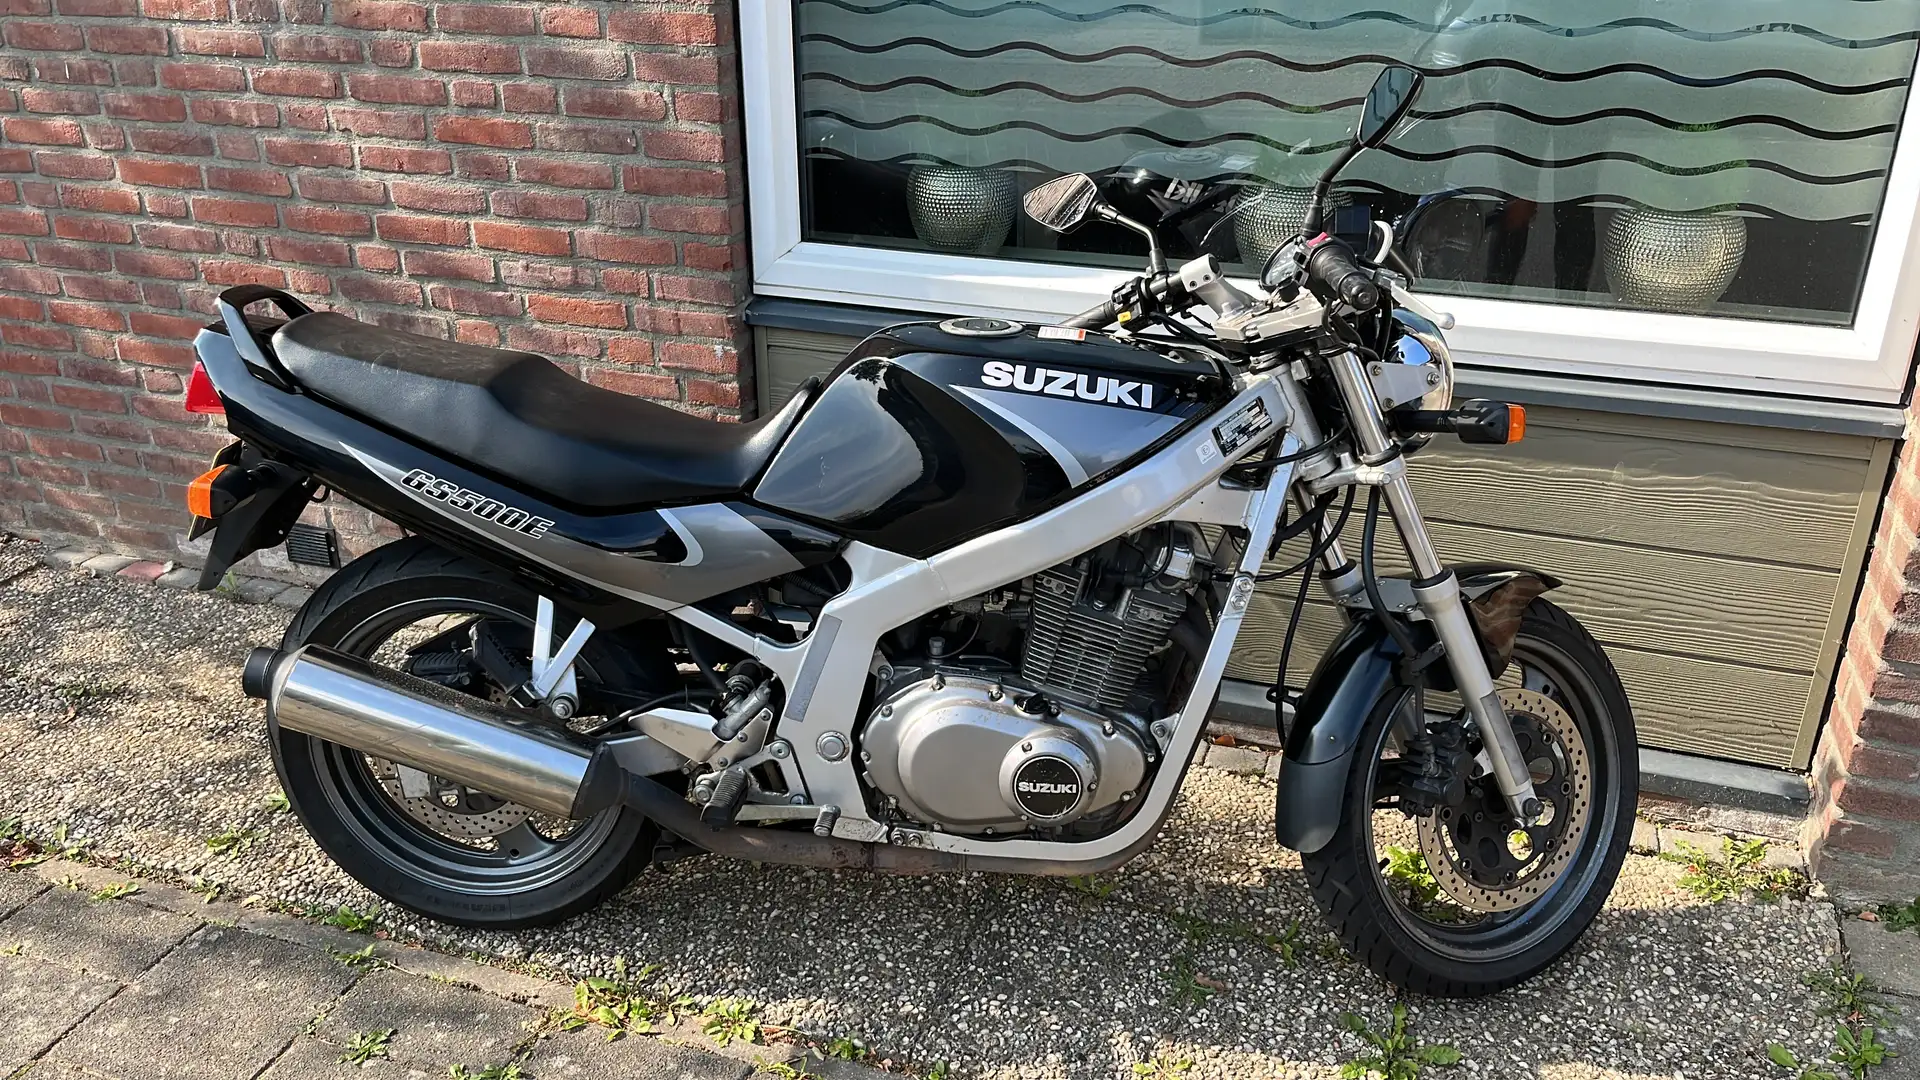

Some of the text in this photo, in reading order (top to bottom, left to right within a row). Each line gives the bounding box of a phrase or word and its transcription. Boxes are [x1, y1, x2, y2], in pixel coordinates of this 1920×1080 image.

[981, 360, 1153, 409] SUZUKI
[400, 468, 555, 540] GS500E
[1018, 781, 1077, 794] SUZUKI
